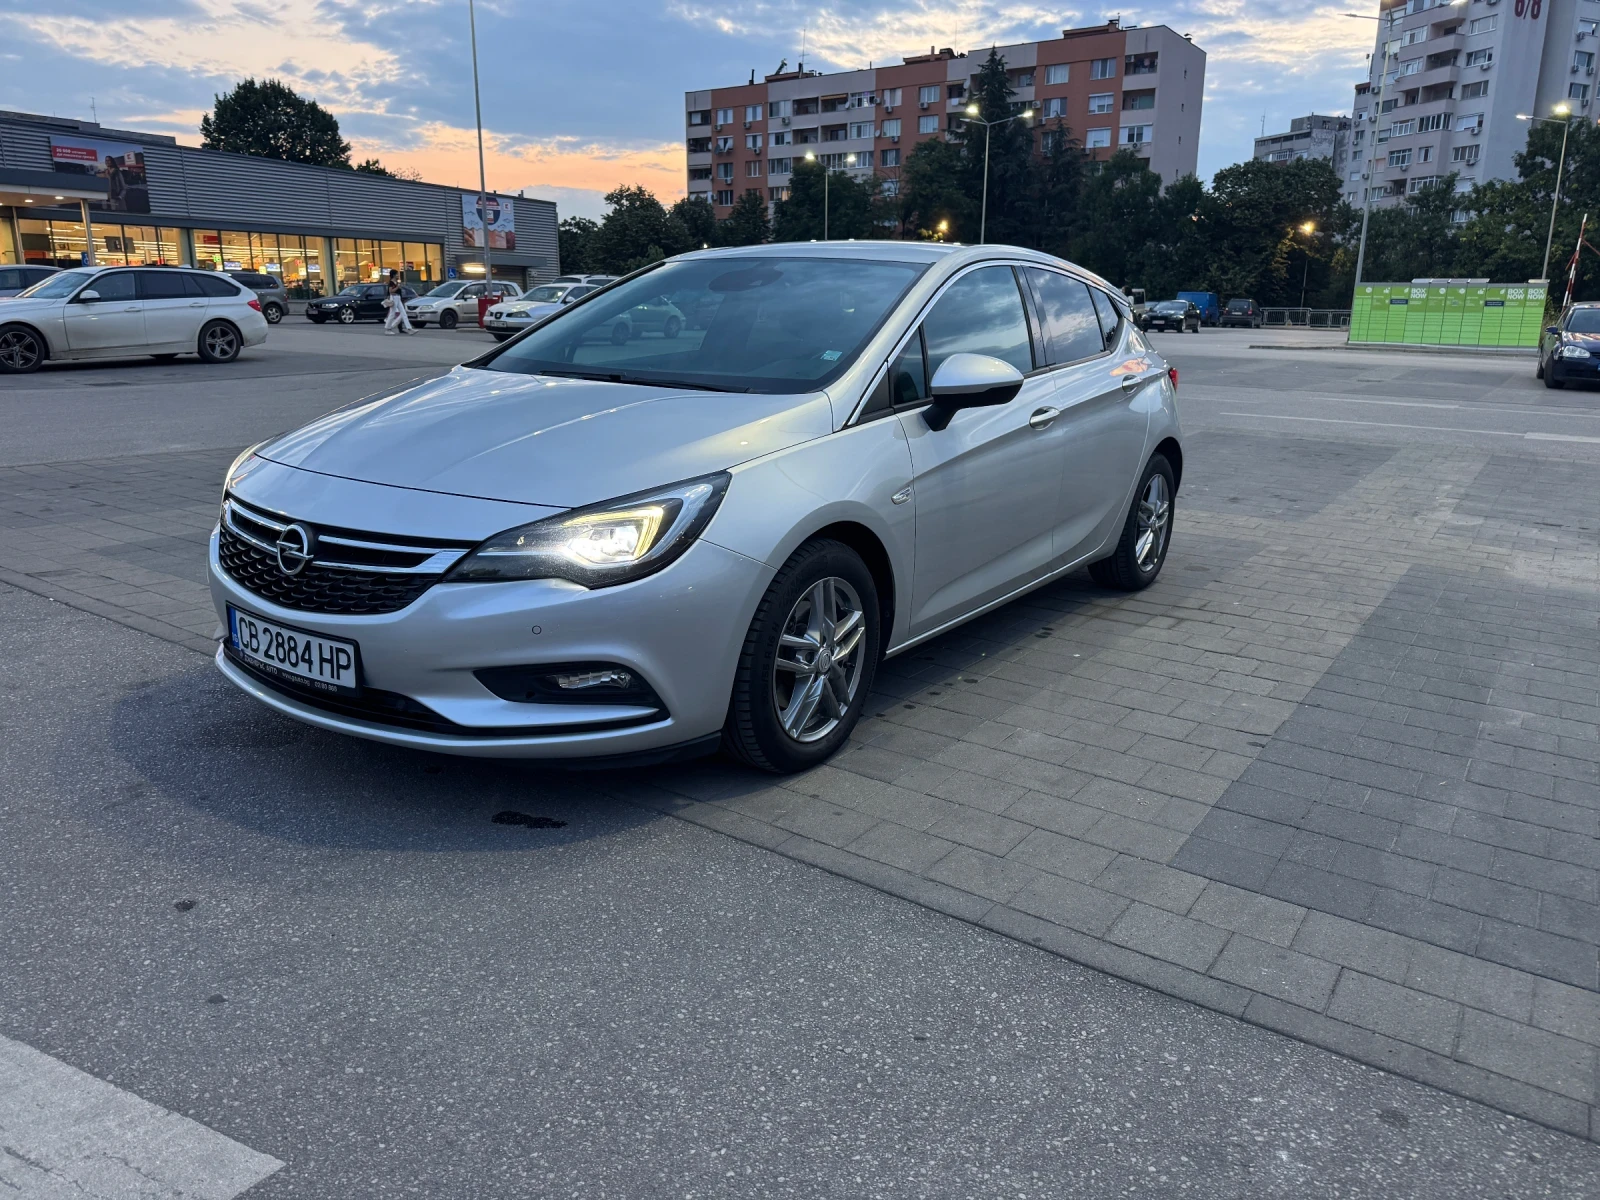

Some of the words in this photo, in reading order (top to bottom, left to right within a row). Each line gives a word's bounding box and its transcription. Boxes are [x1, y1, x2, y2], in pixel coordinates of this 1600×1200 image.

[239, 617, 260, 653] CB
[262, 627, 313, 673] 2884
[318, 642, 351, 680] HP
